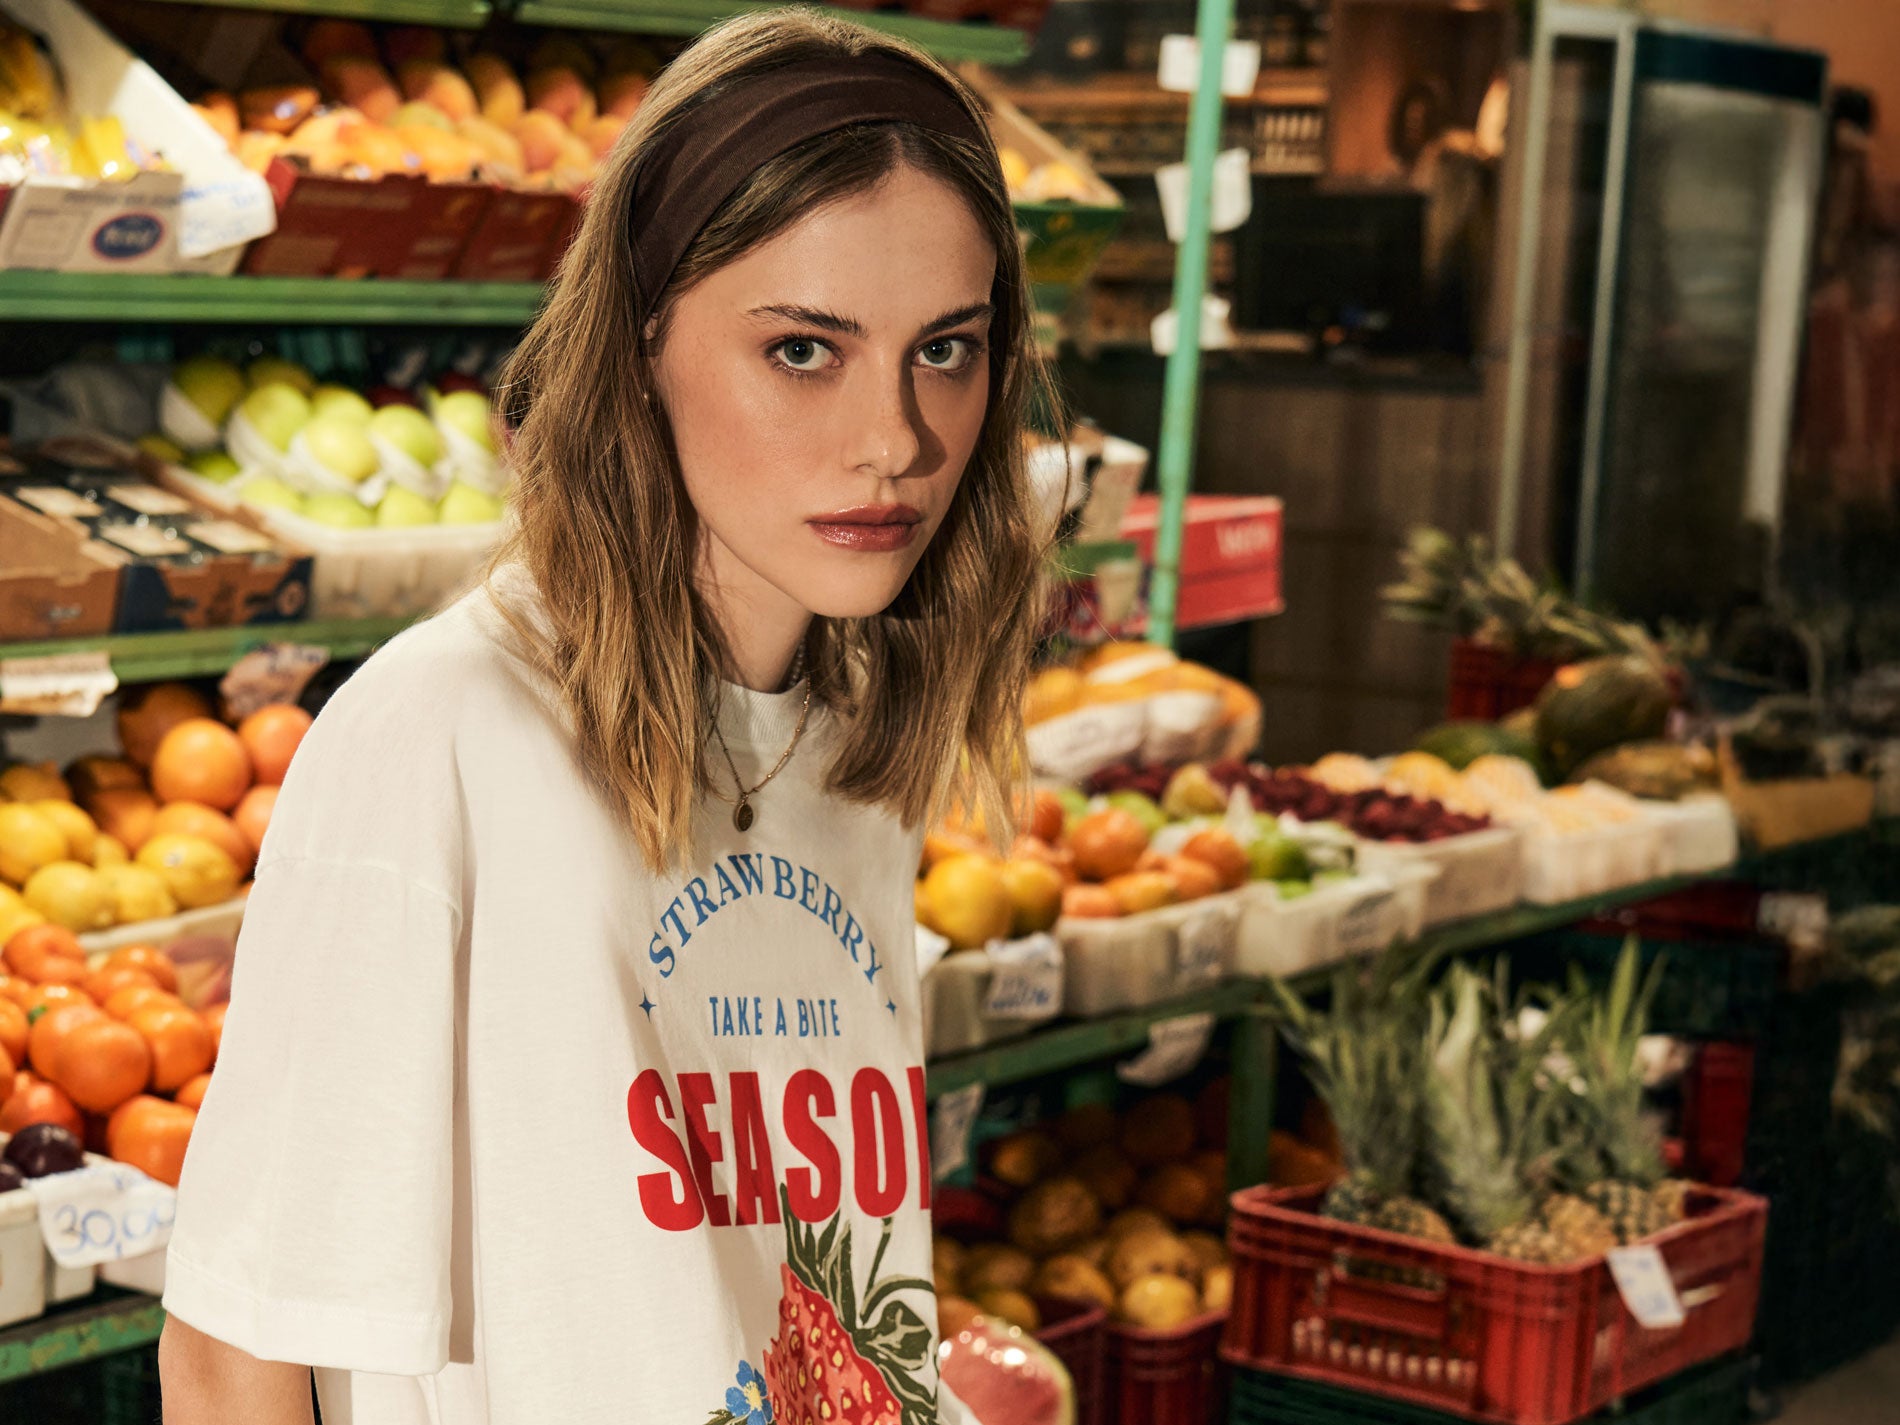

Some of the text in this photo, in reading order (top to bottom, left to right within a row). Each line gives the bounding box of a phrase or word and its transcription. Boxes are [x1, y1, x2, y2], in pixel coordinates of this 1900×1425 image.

[648, 852, 884, 985] STRAWBERRY
[708, 996, 842, 1038] TAKE A BITE
